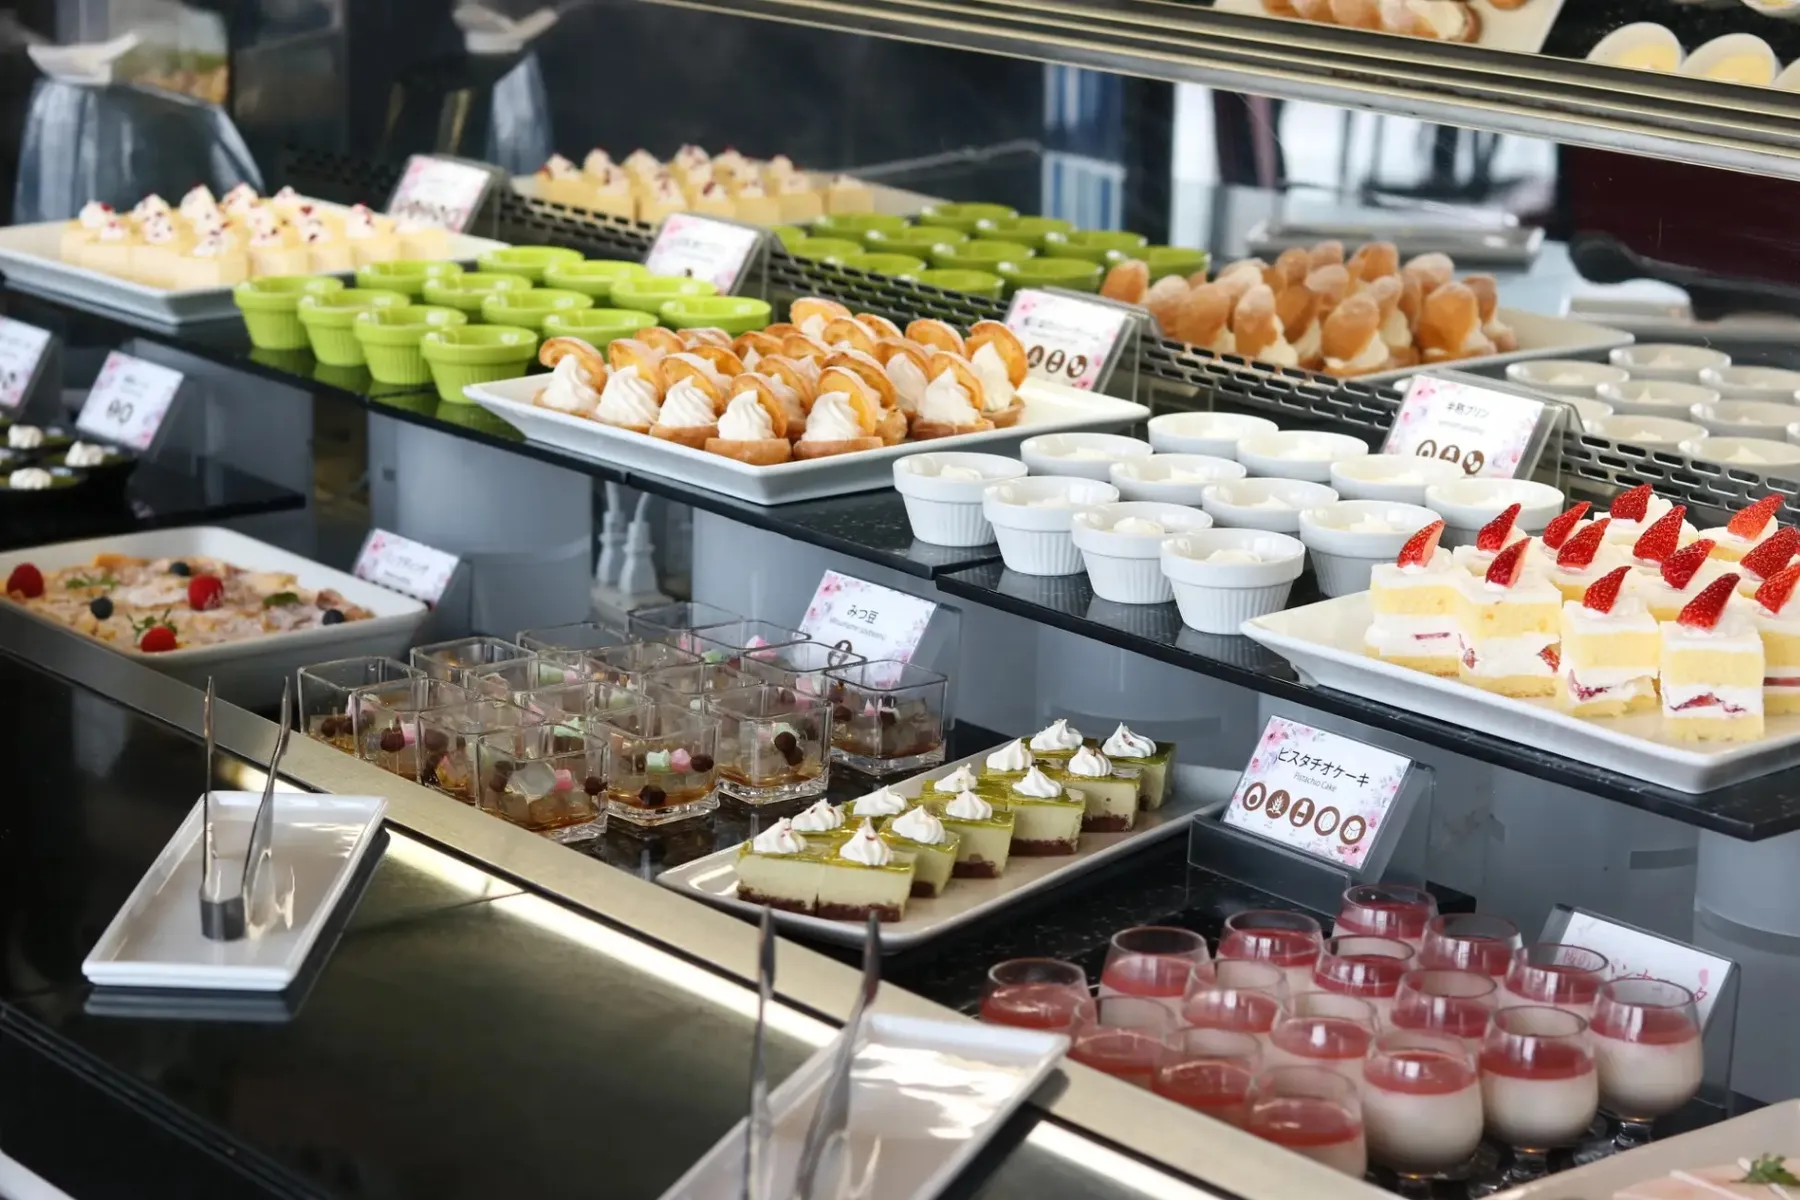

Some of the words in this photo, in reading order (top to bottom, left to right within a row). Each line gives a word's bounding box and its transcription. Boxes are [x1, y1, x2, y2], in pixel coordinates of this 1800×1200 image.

[846, 604, 879, 625] みつ豆
[1277, 747, 1370, 787] ピスタチオケーキ
[1293, 772, 1320, 787] Pistachio
[1320, 780, 1337, 793] Cake
